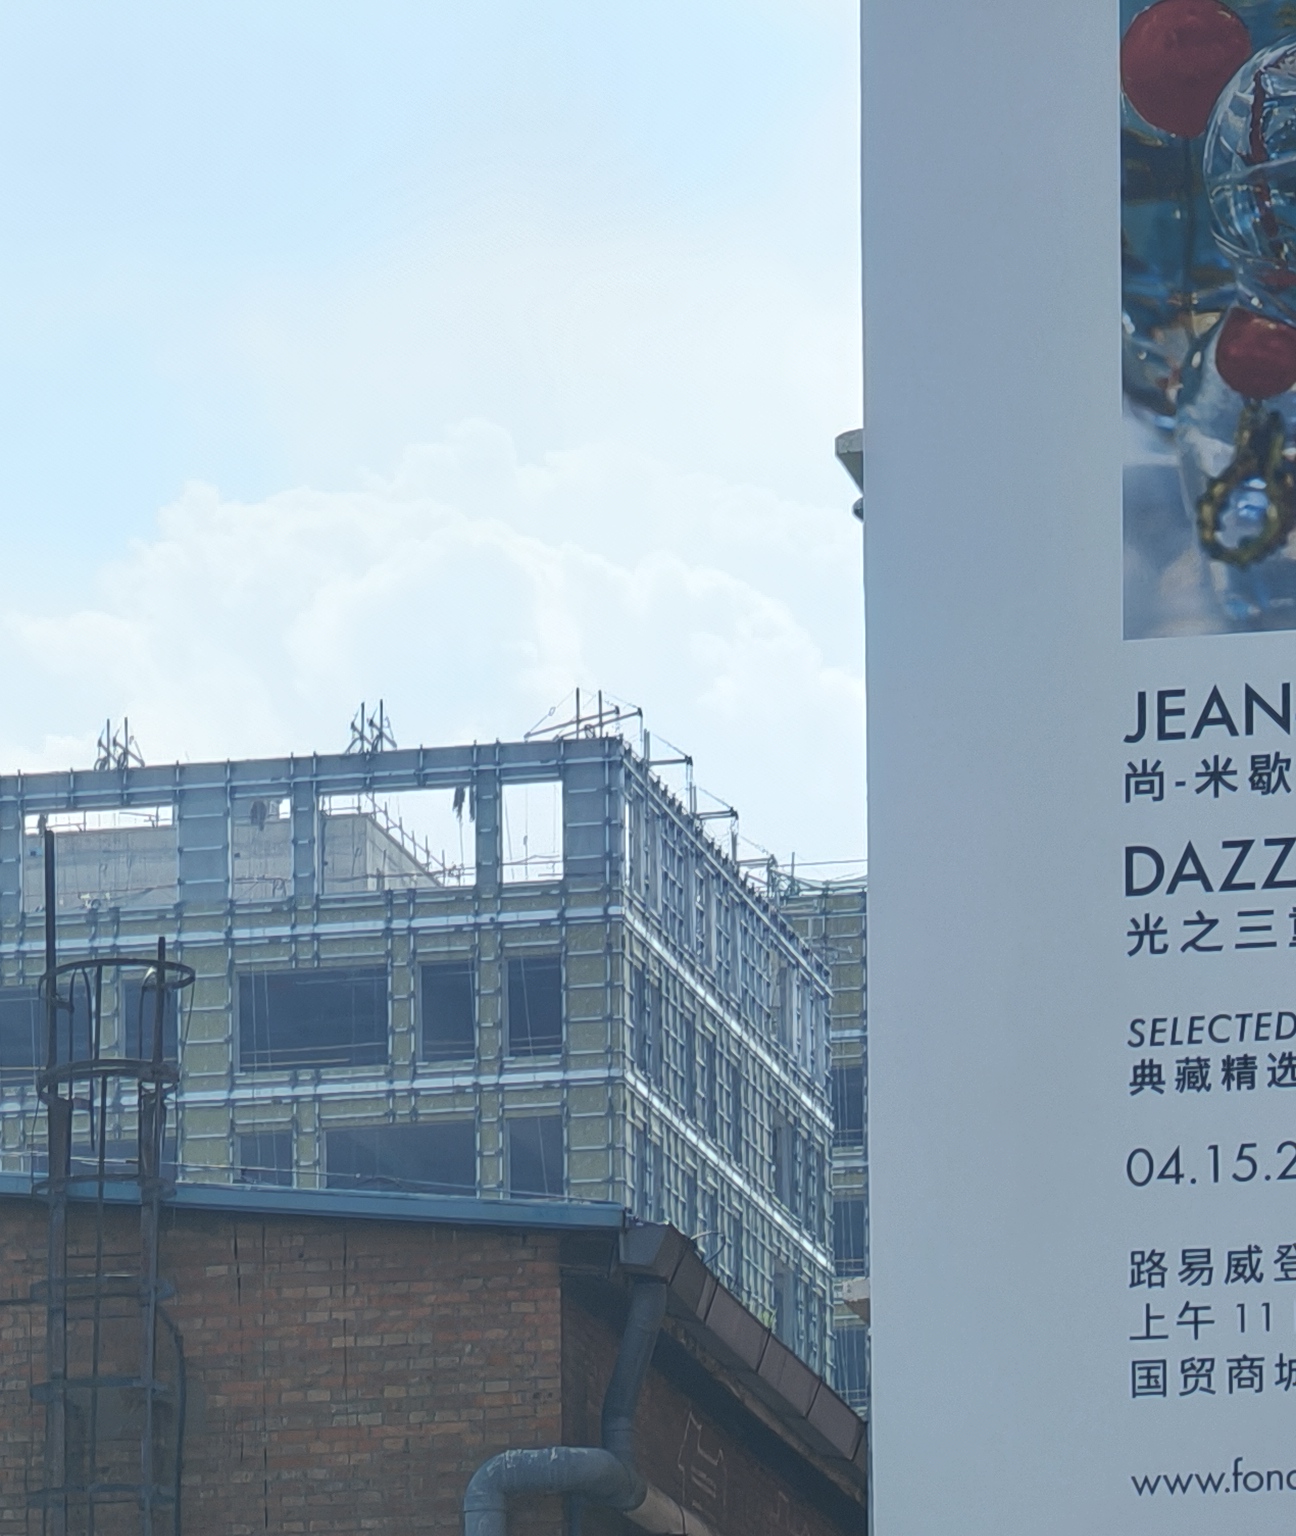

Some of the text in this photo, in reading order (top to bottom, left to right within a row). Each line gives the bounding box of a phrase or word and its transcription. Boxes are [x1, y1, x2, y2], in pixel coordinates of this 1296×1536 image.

[1124, 751, 1292, 803] 尚-米歇
[1124, 837, 1296, 897] DAZZ
[1126, 907, 1296, 957] 光之三
[1127, 1011, 1296, 1048] SELECTED
[1129, 1051, 1296, 1096] 典藏精选
[1126, 1140, 1296, 1187] 04.15.2
